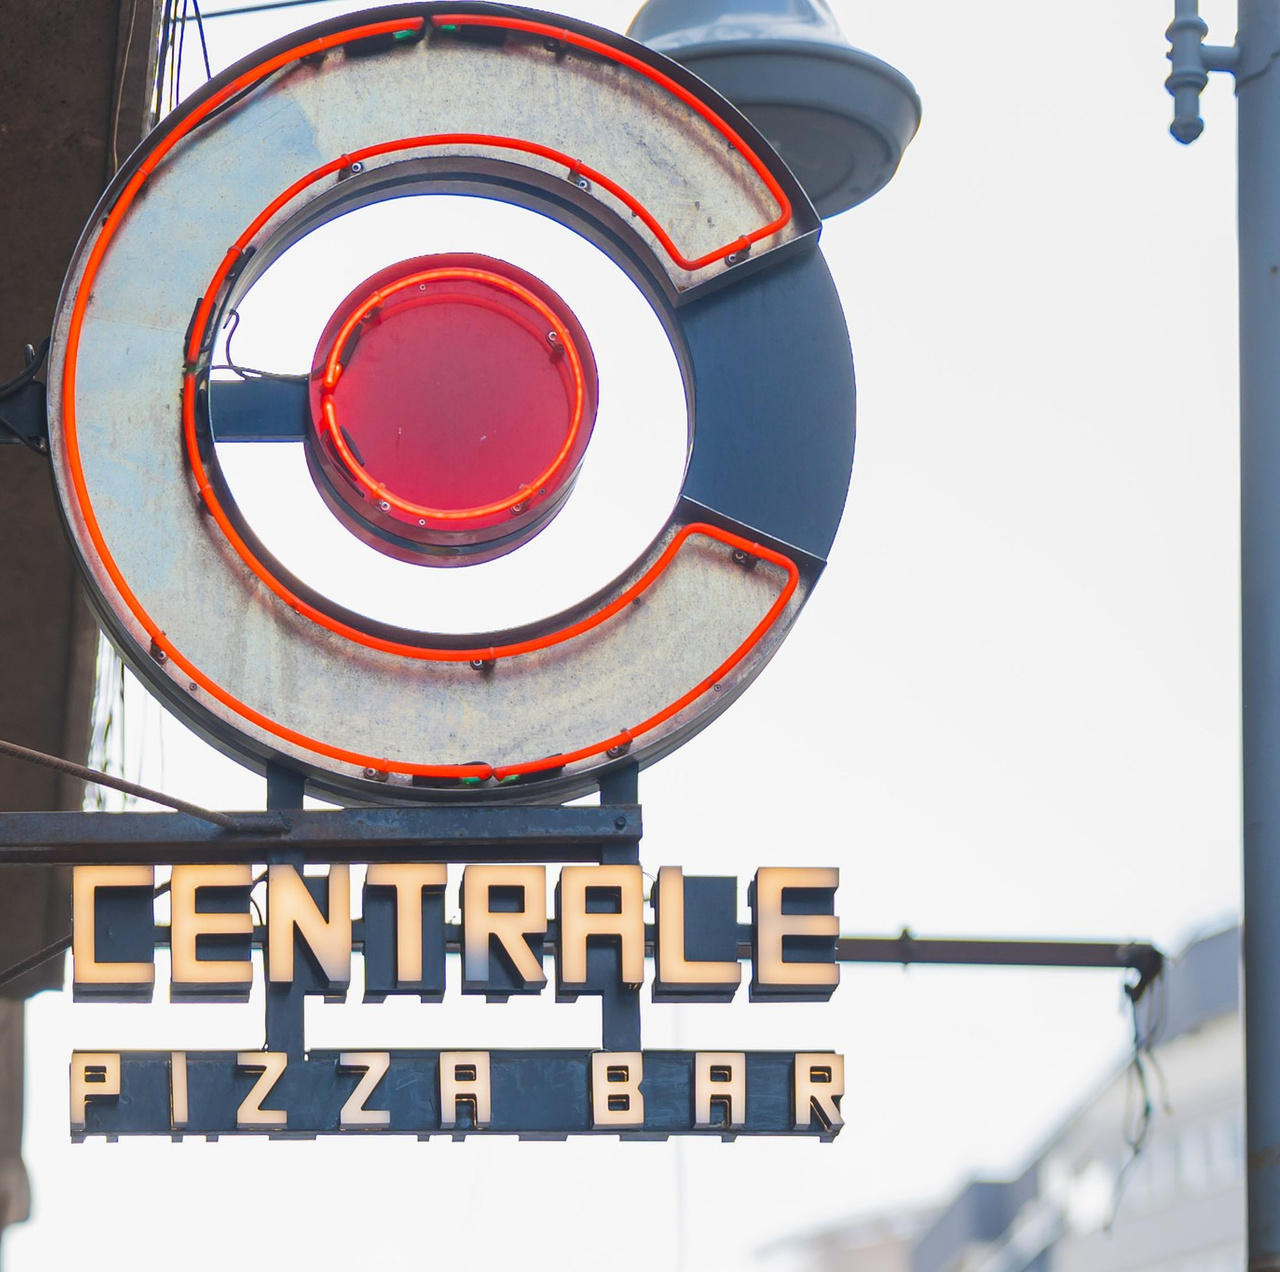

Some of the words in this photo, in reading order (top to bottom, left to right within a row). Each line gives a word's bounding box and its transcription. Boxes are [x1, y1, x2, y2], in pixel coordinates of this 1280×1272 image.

[71, 864, 841, 1000] CENTRALE
[70, 1051, 491, 1131] PIZZA
[590, 1051, 846, 1132] BAR
